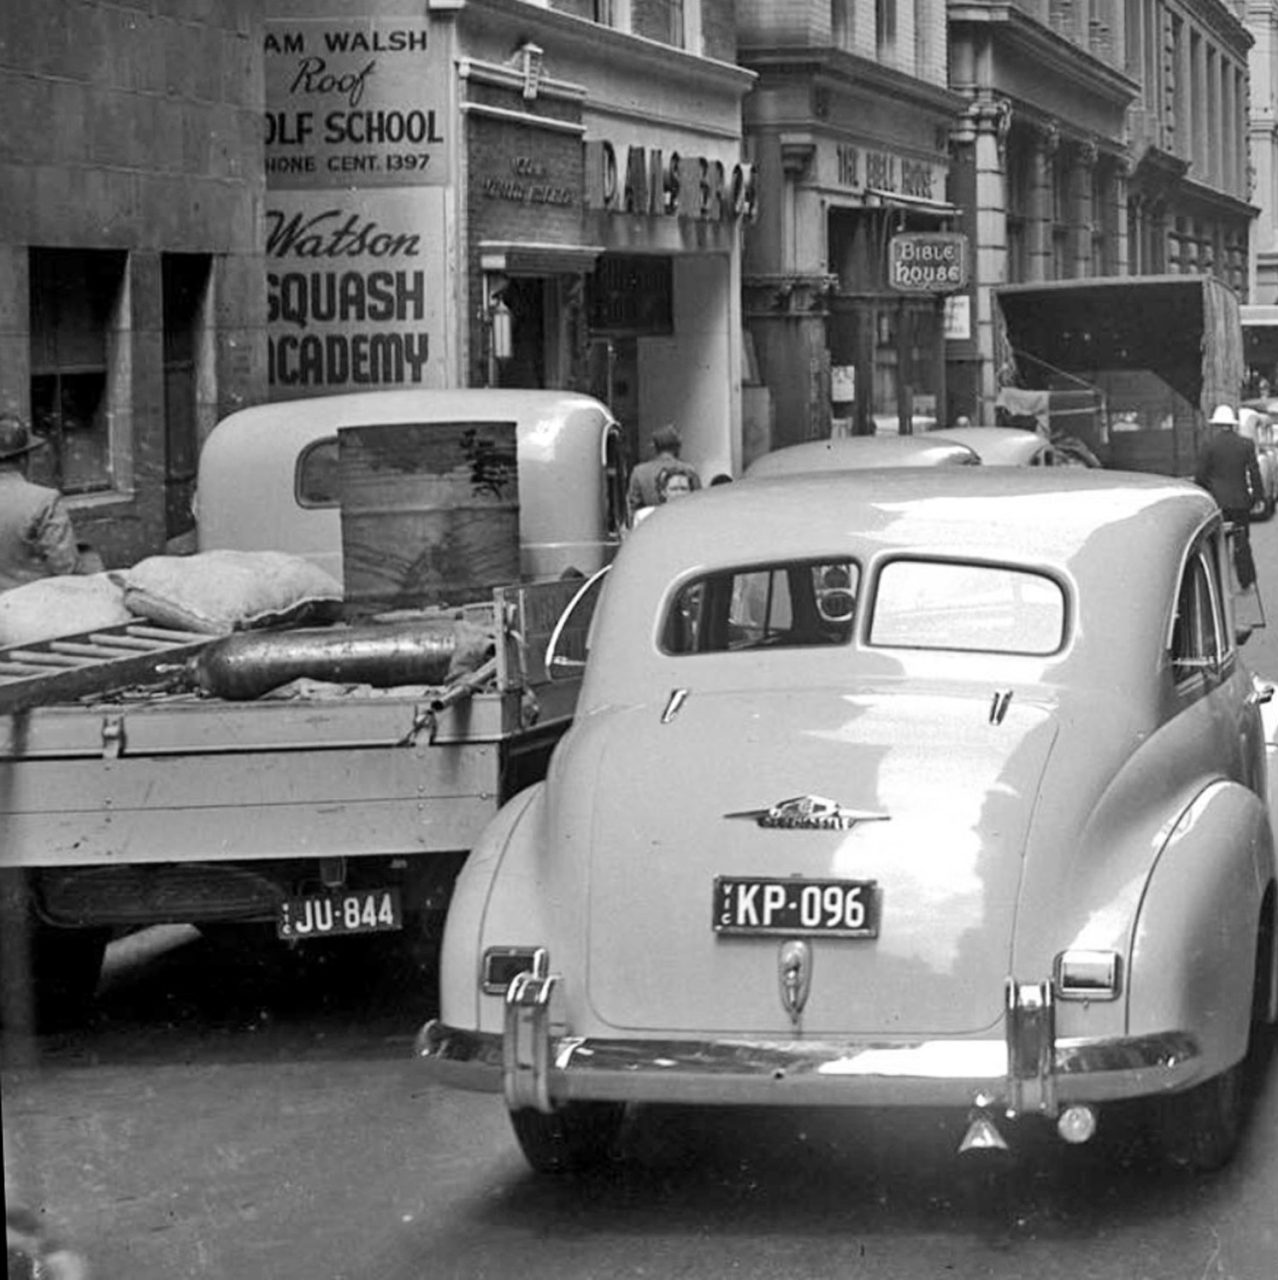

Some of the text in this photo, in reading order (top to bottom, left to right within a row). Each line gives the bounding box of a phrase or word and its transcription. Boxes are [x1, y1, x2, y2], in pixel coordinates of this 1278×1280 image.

[264, 30, 427, 54] AM WALSH
[290, 56, 376, 107] Roof
[324, 109, 444, 145] SCHOOL
[386, 153, 431, 171] 1397
[266, 209, 421, 258] Watson
[268, 332, 429, 385] CADEMY
[721, 884, 732, 925] VIC
